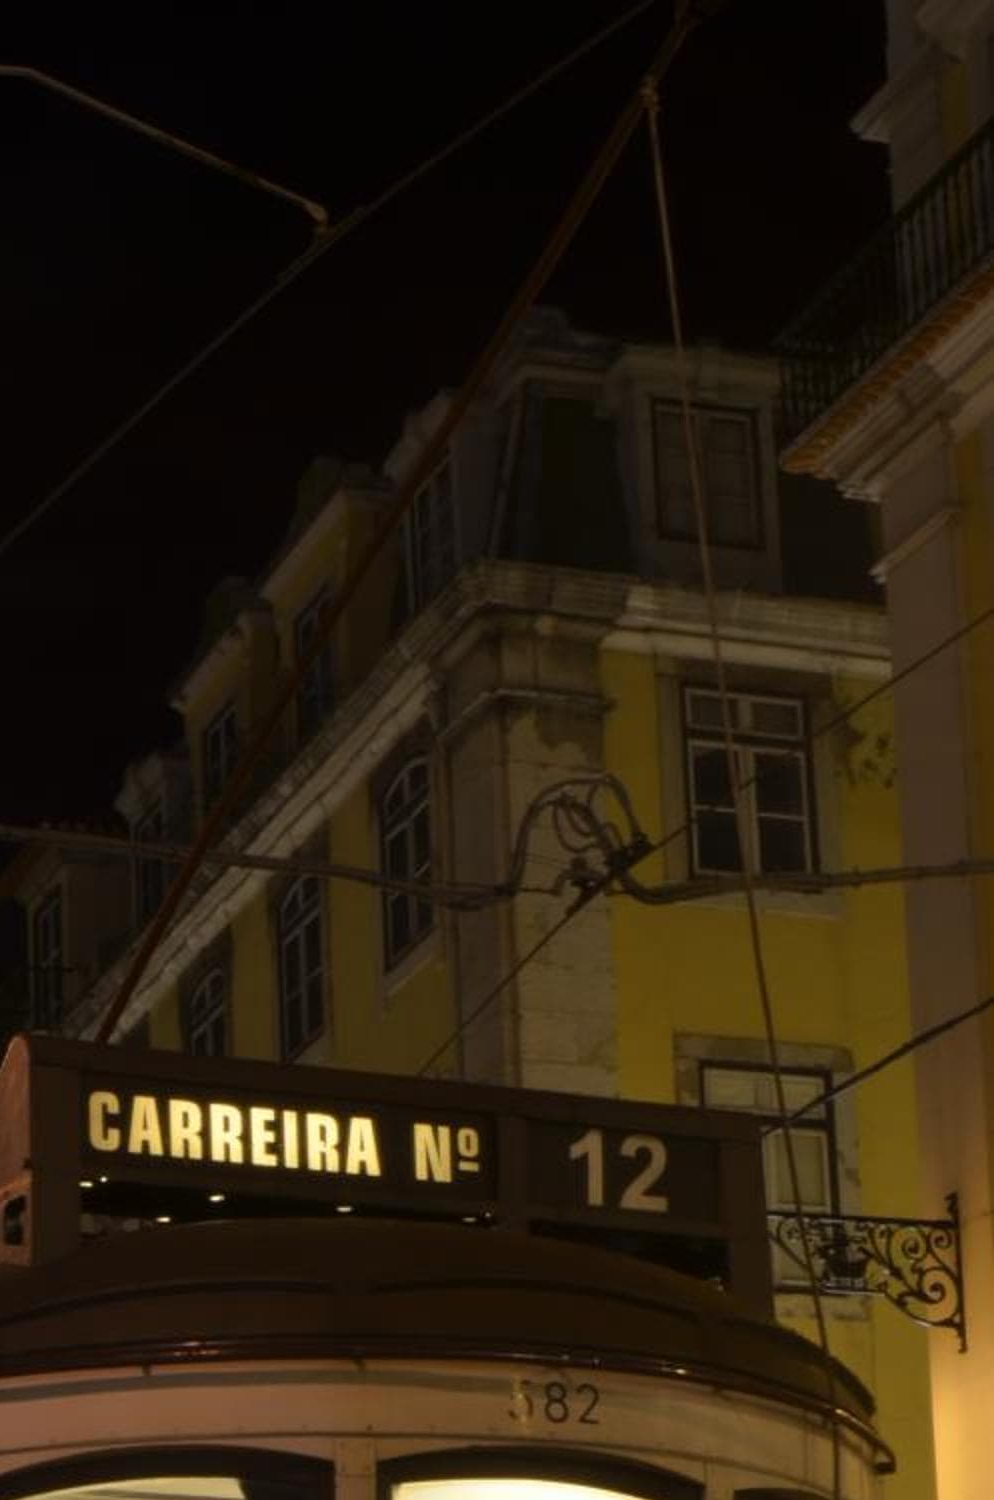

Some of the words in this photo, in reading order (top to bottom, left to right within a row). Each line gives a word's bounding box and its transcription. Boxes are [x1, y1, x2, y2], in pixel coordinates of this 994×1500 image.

[88, 1090, 382, 1178] CARREIRA
[413, 1122, 480, 1184] Nº
[569, 1128, 669, 1213] 12
[507, 1379, 601, 1425] 582
